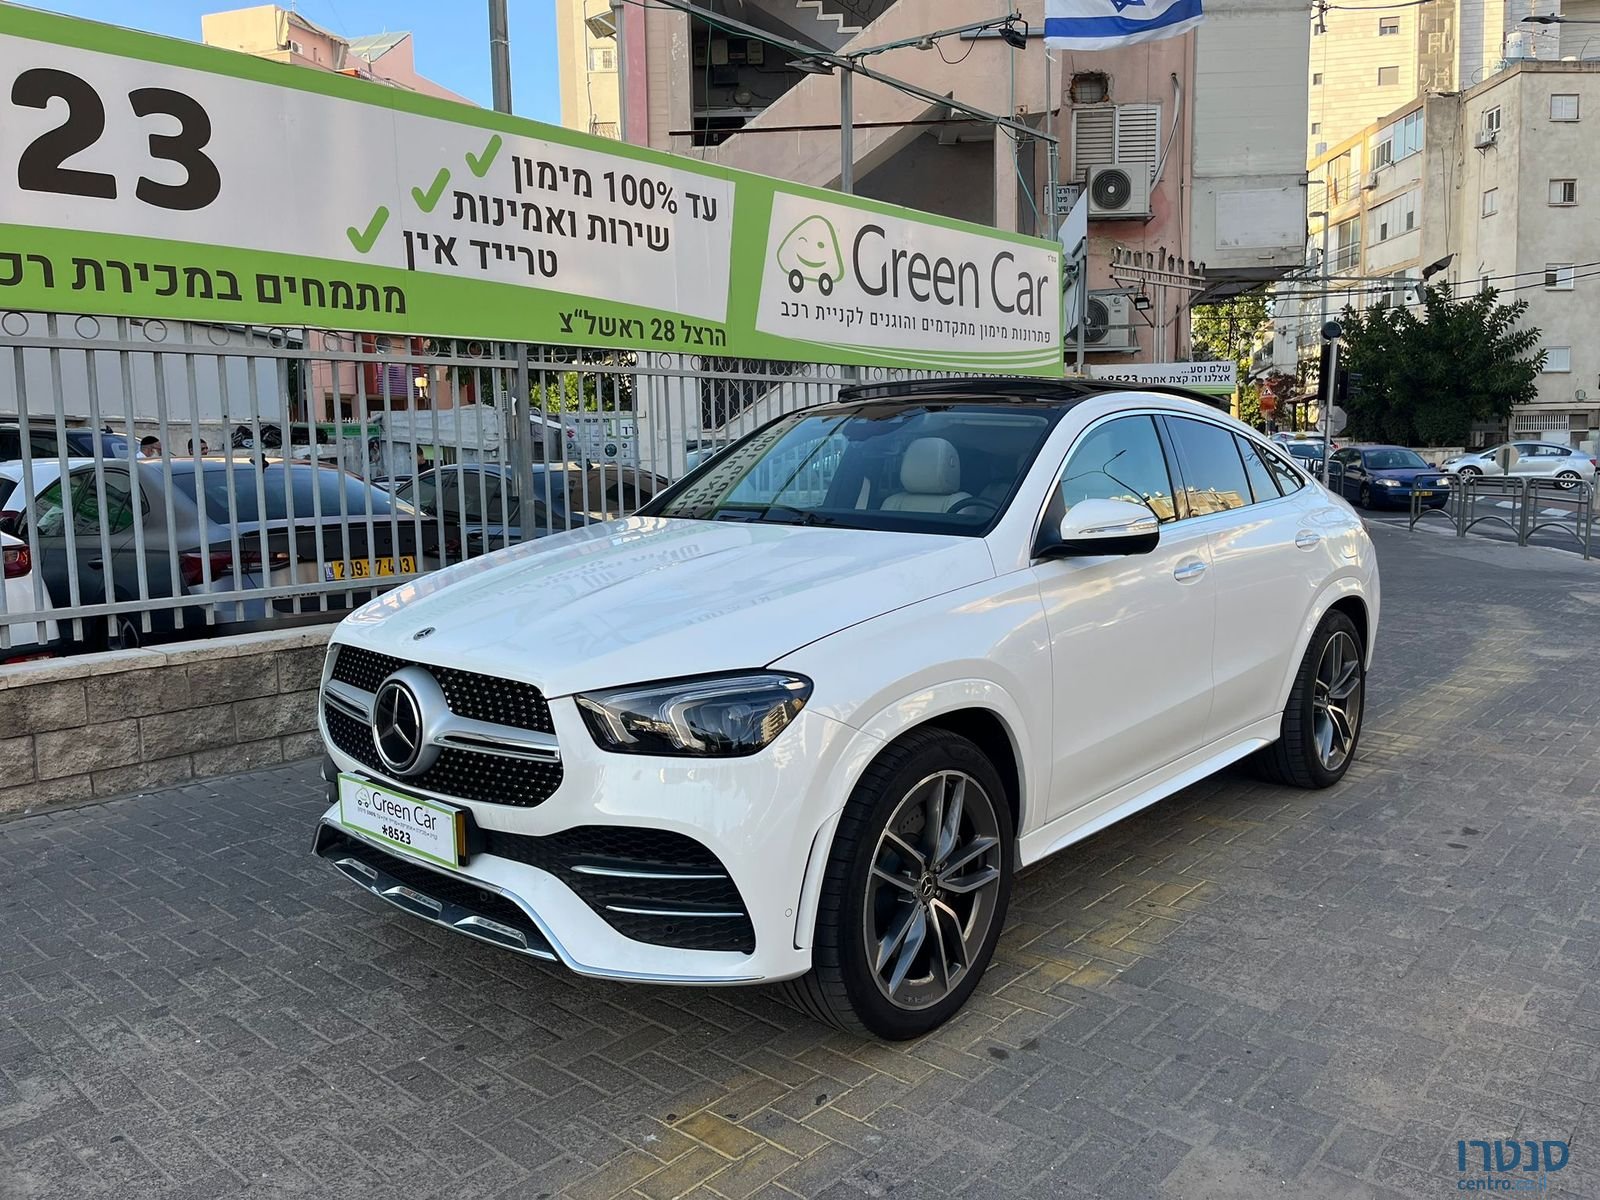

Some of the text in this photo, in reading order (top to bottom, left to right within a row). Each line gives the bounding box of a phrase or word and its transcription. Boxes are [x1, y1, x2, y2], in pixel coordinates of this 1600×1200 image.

[11, 67, 221, 211] 23
[511, 155, 717, 222] עד 100% מימון
[452, 190, 670, 252] שירות ואמינות
[403, 230, 558, 278] טרייד אין
[852, 224, 1049, 317] Green Car
[71, 257, 243, 301] במכירת
[255, 272, 407, 314] מתמחים
[650, 317, 676, 343] 28
[680, 320, 727, 347] הרצל
[780, 301, 1051, 343] פתרונות מימון מתקדמים והוגנים לקניית רכב
[1169, 374, 1188, 385] קצת
[1191, 374, 1203, 383] זה
[1204, 374, 1230, 382] אצלנו
[1210, 364, 1231, 373] שלם
[372, 791, 411, 822] Green
[413, 806, 437, 831] Car
